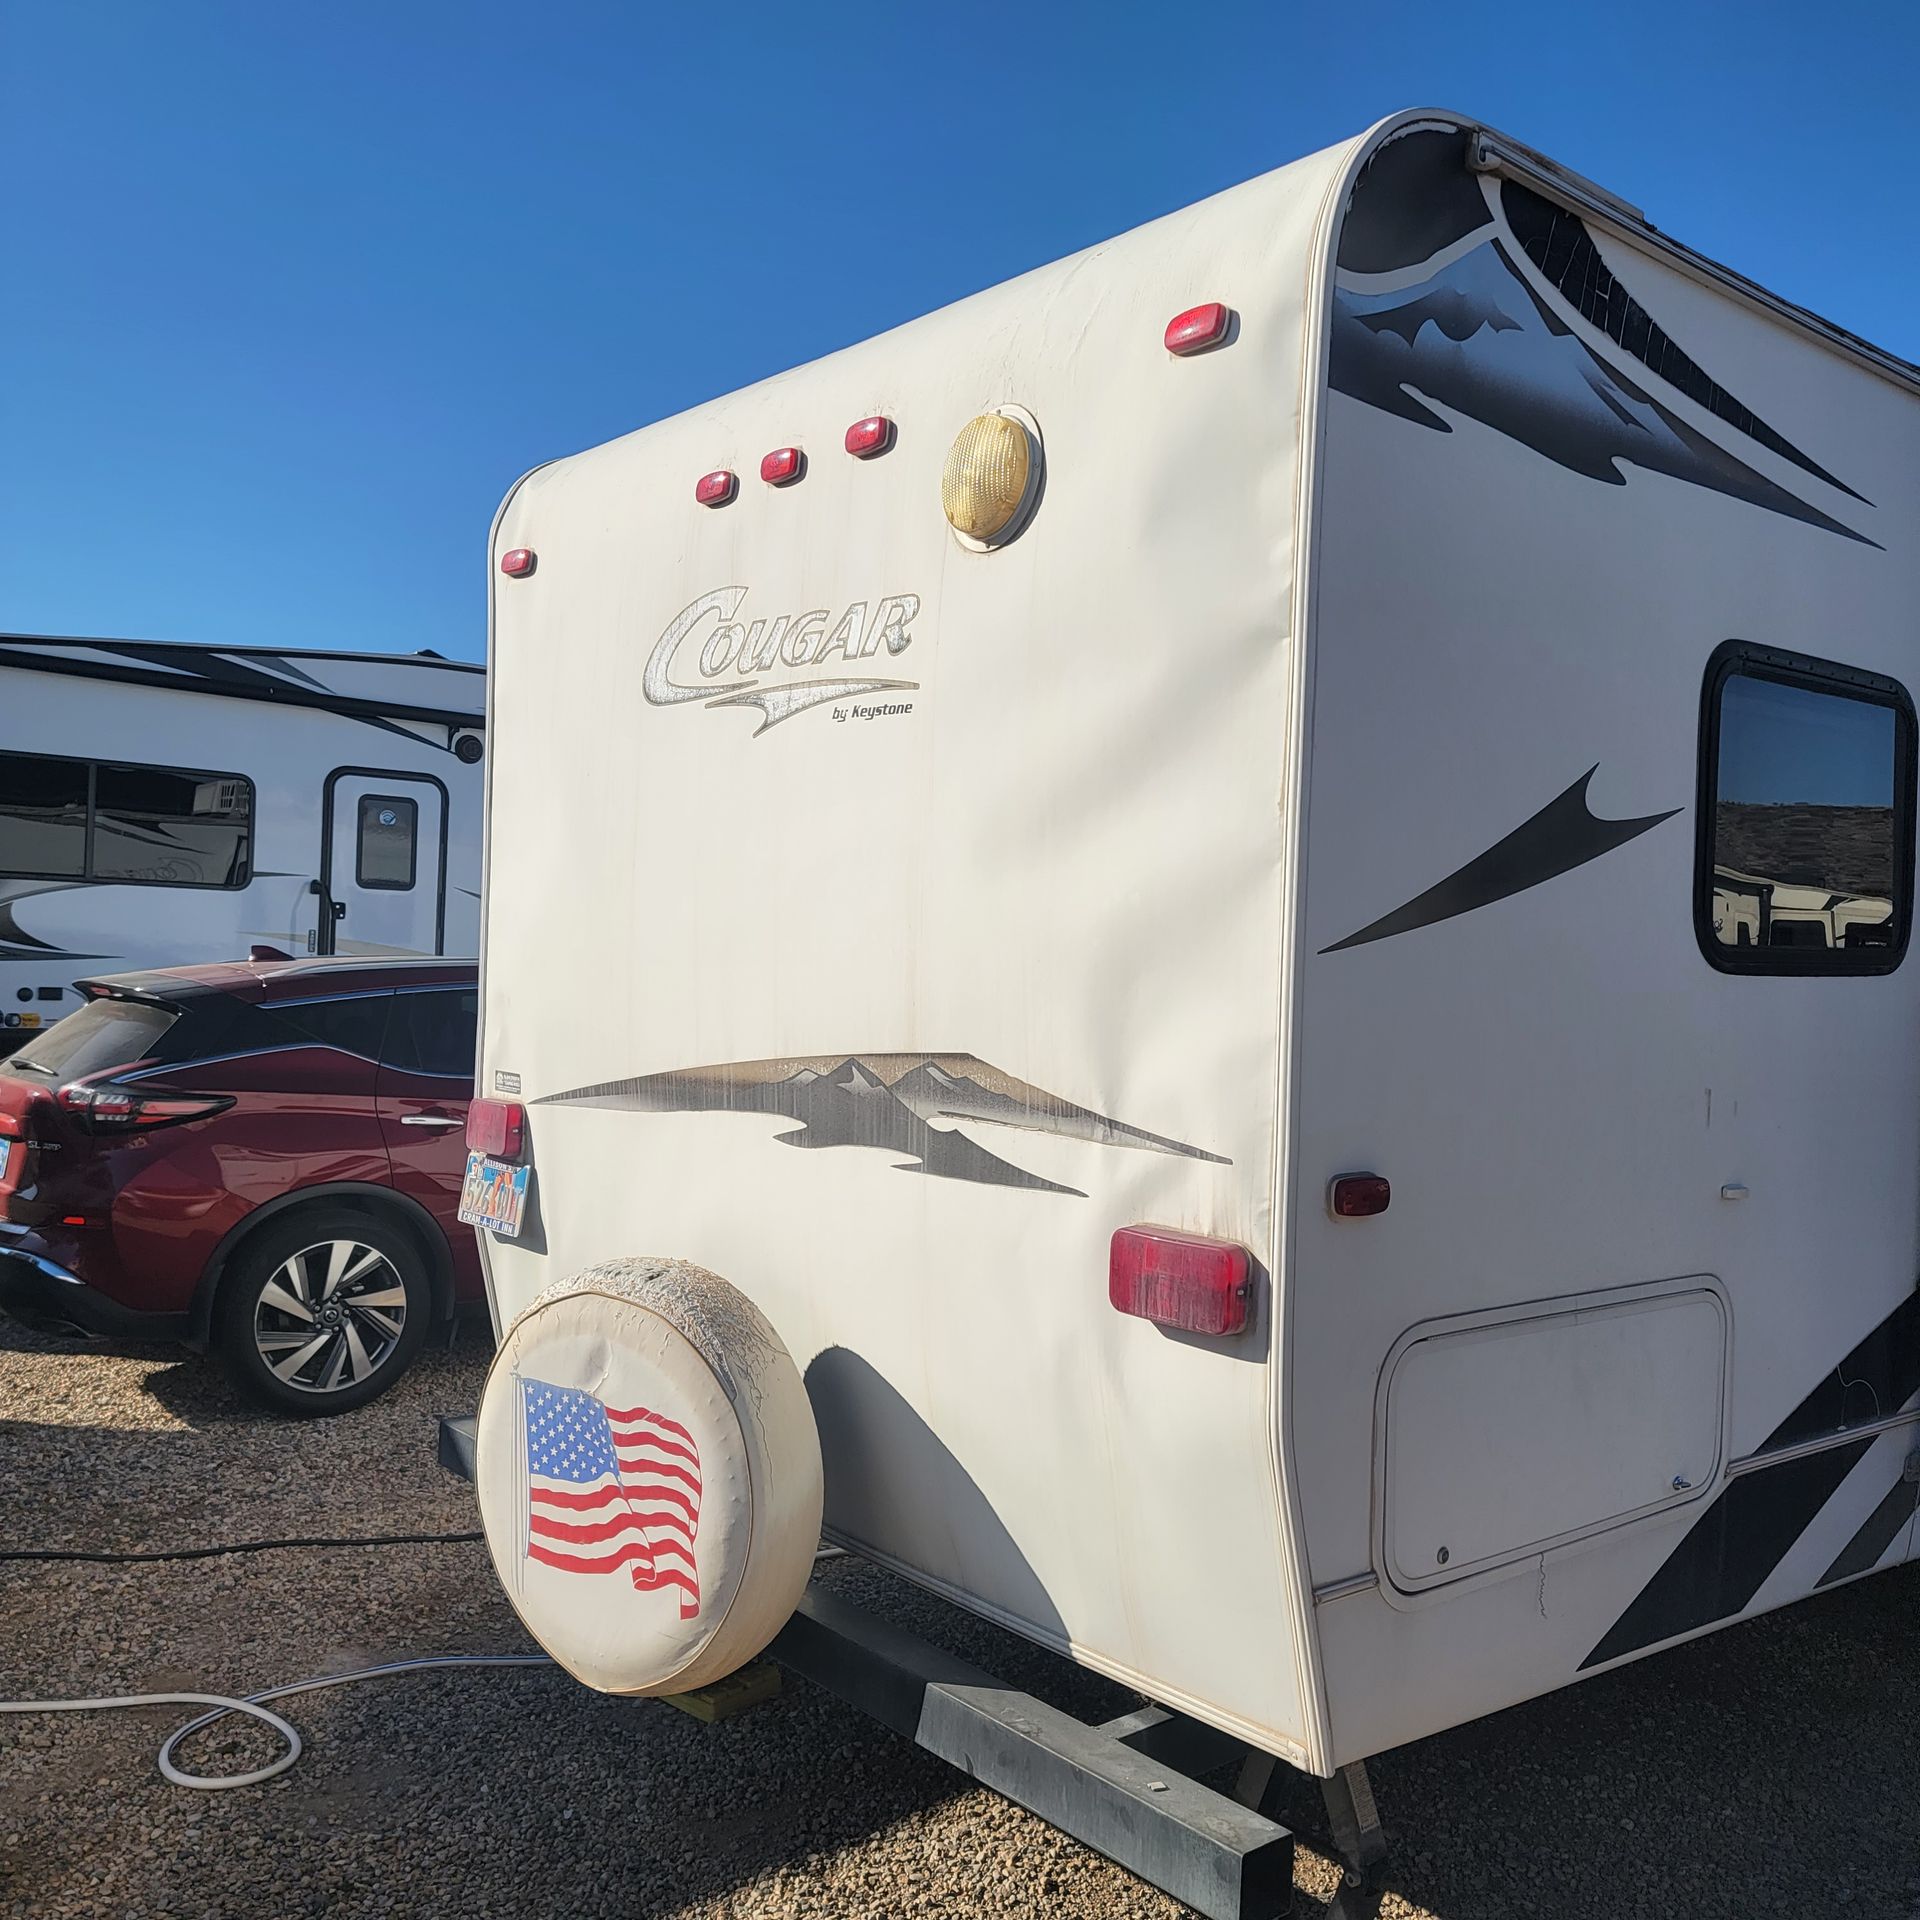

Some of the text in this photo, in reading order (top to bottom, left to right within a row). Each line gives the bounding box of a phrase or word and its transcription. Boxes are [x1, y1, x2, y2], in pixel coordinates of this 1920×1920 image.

[832, 703, 913, 722] by Keystone
[501, 1222, 513, 1234] INN
